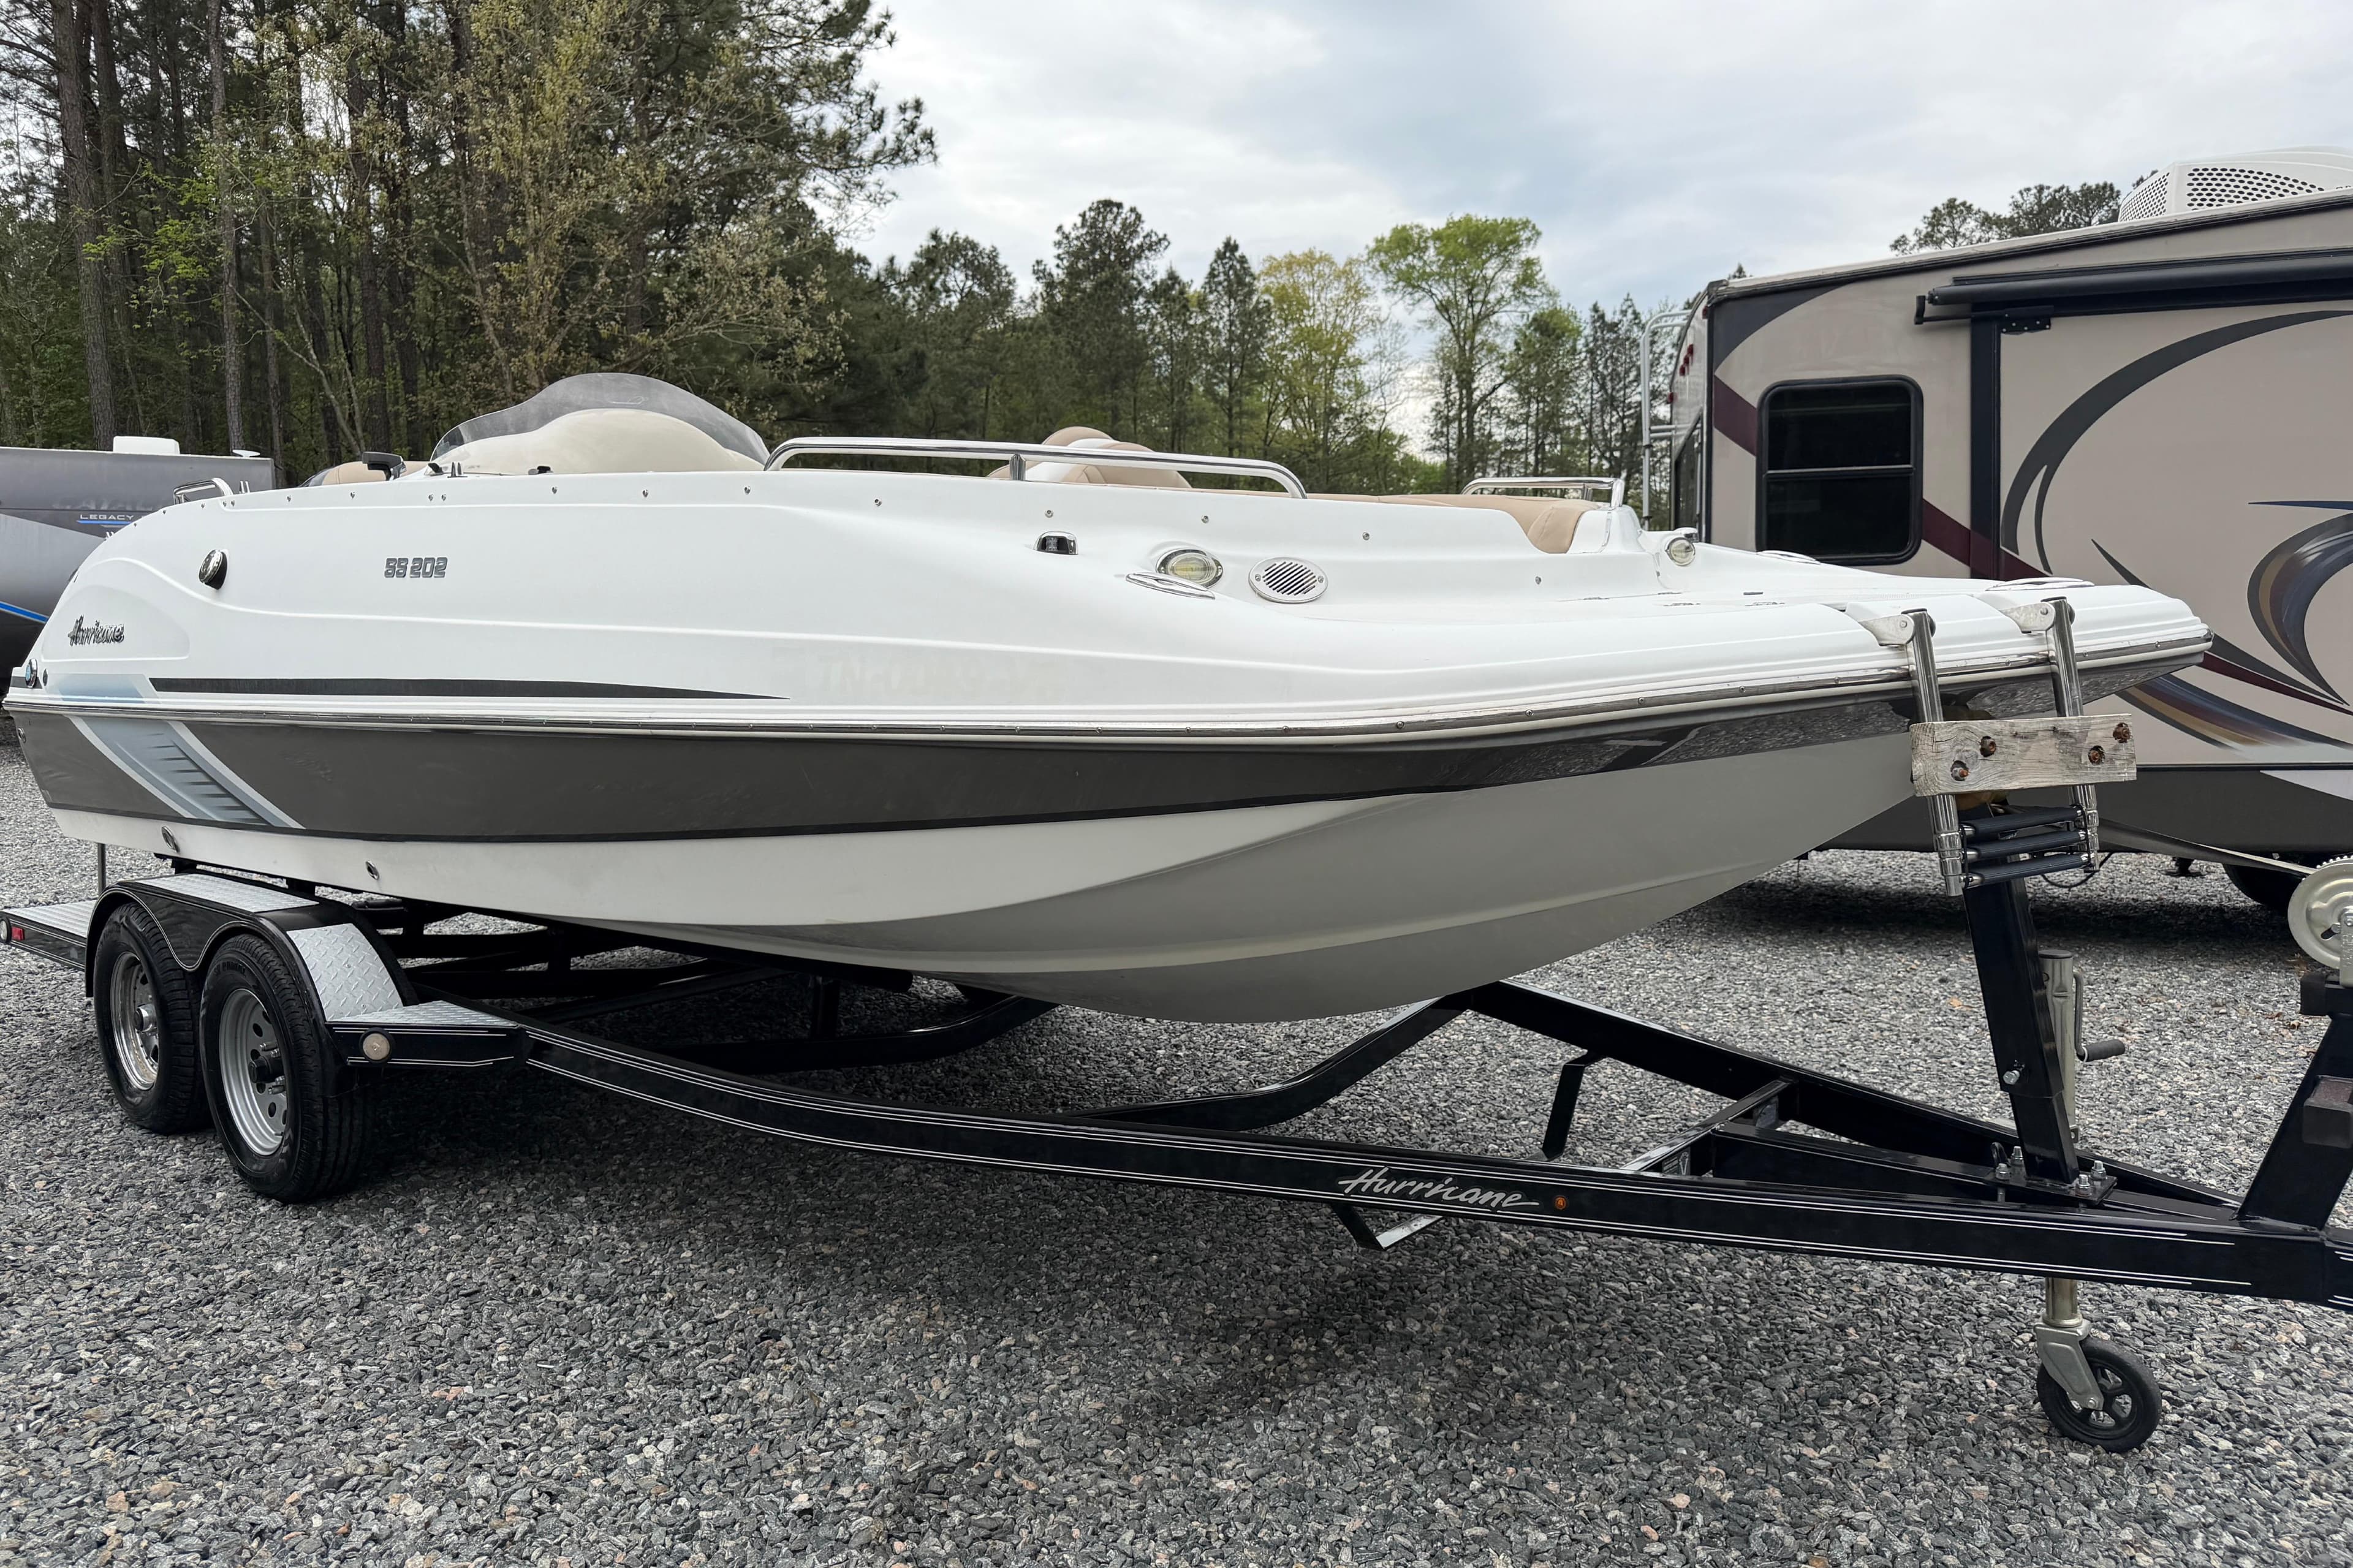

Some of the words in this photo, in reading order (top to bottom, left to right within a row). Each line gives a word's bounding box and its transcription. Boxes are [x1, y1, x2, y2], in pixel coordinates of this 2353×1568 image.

[384, 558, 409, 578] SS
[409, 556, 448, 578] 202
[1338, 1165, 1540, 1208] Hurricane
